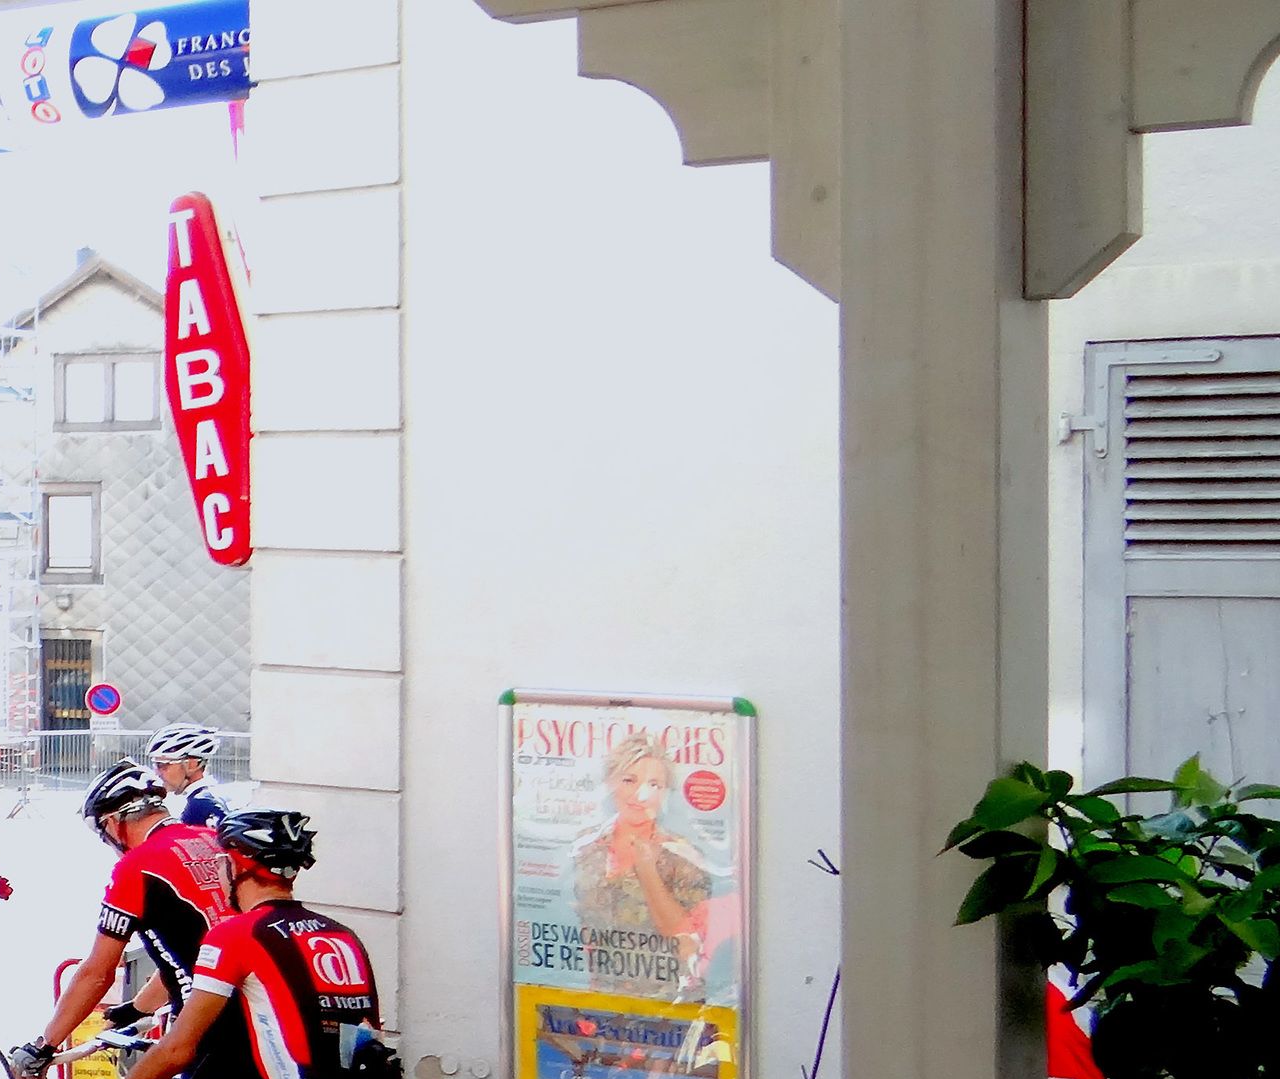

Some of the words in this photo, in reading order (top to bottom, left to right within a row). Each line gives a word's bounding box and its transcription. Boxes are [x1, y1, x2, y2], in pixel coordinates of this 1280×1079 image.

[188, 59, 231, 81] DES
[168, 208, 233, 551] TABAC
[268, 918, 326, 938] Team
[517, 920, 531, 968] DOSSIER
[532, 922, 559, 942] DES
[561, 925, 636, 951] VACANCES
[639, 932, 681, 955] POUR
[531, 943, 554, 969] SE
[561, 944, 680, 982] RETROUVER
